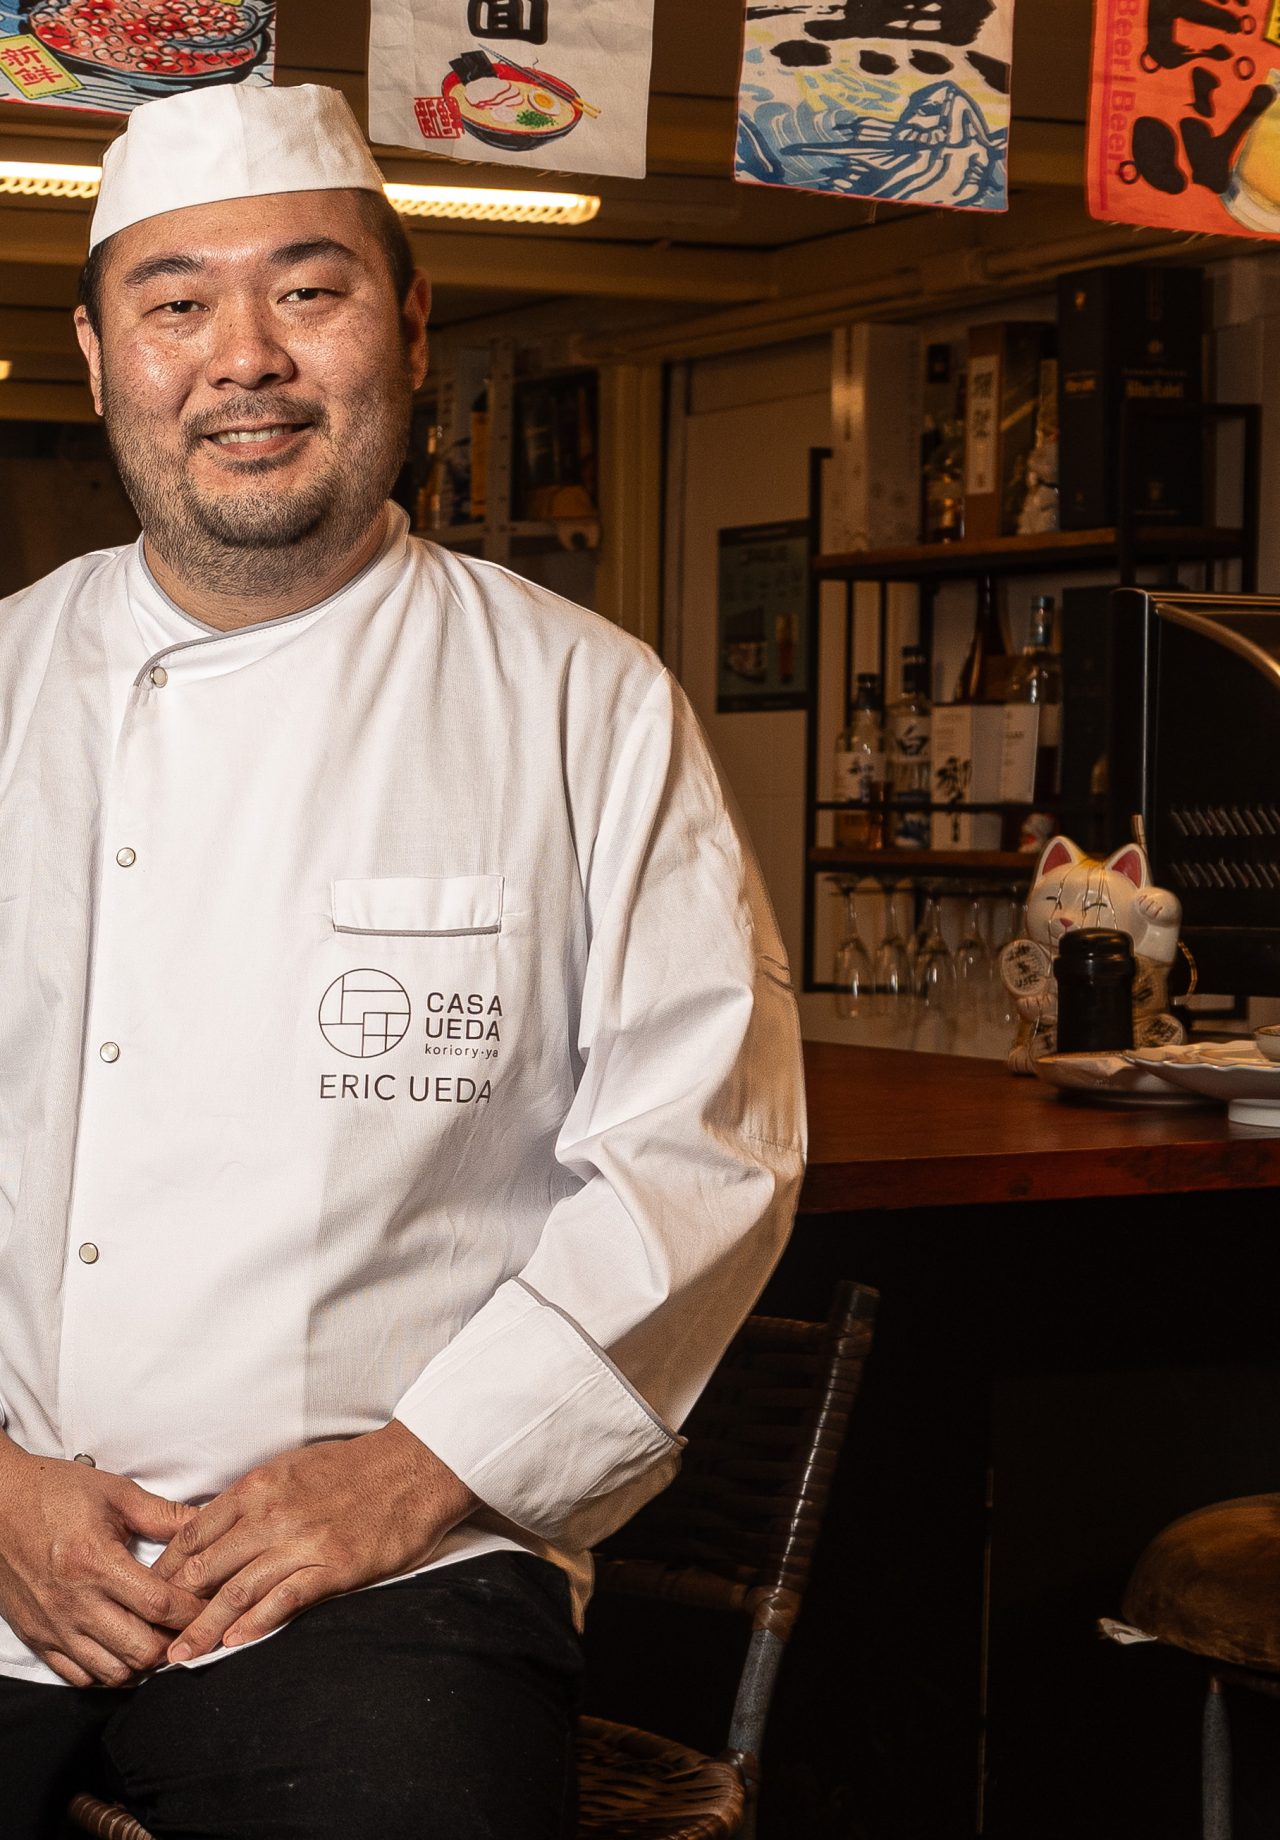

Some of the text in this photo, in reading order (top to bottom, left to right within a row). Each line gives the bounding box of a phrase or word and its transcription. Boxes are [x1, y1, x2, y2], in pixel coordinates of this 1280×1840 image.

[0, 45, 63, 86] 新鮮
[427, 992, 503, 1016] CASA
[425, 1017, 500, 1041] UEDA
[320, 1074, 492, 1104] ERIC UEDA
